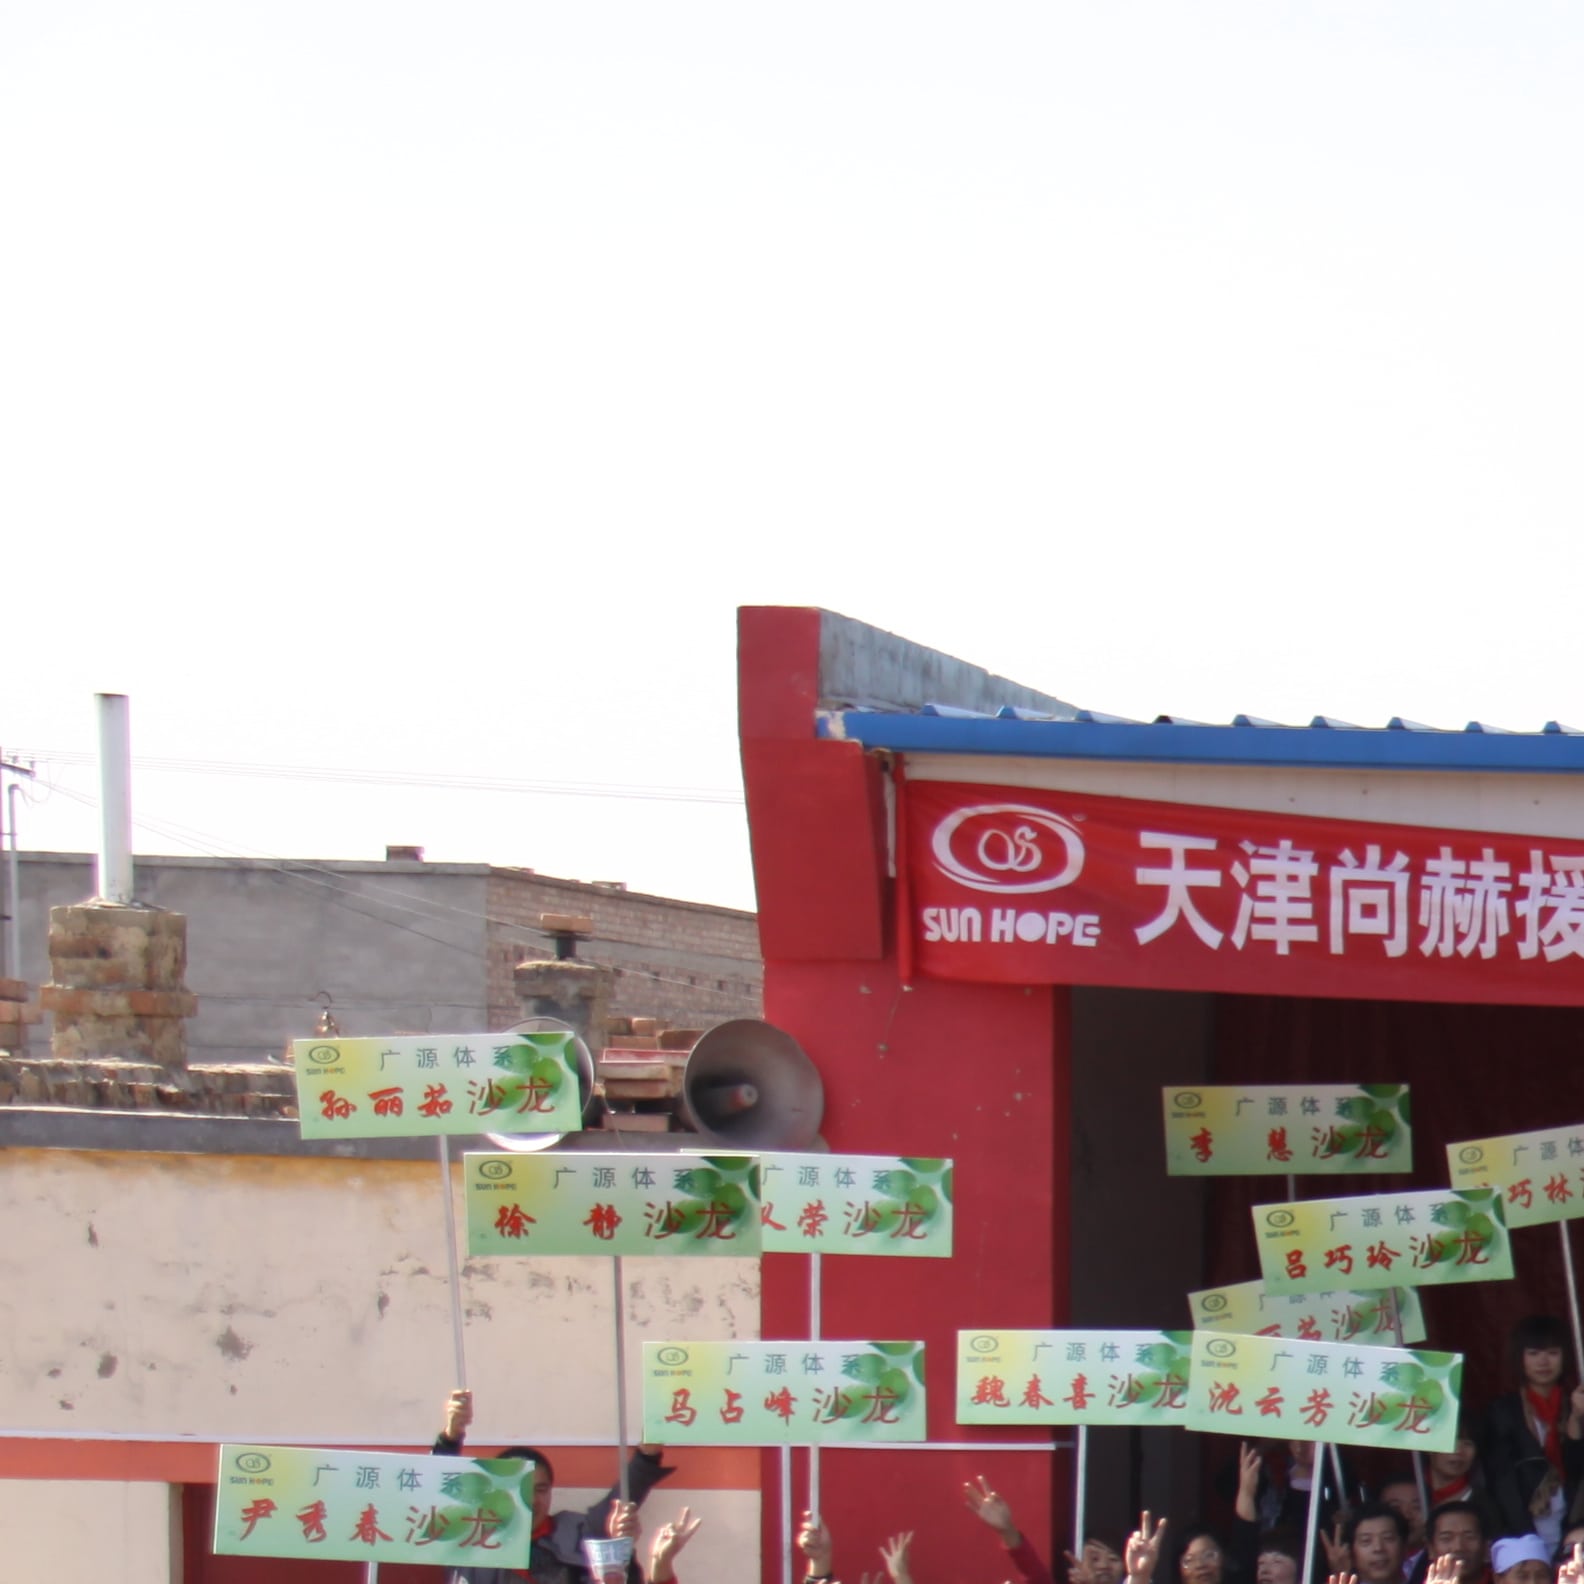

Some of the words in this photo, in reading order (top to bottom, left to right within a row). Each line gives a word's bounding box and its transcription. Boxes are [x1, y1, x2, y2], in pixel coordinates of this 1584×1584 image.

[923, 907, 982, 943] SUN
[990, 908, 1101, 947] HOPE
[379, 1045, 515, 1071] 广源体系
[320, 1077, 555, 1120] 孙丽茹沙龙
[553, 1166, 697, 1190] 广源体系
[726, 1353, 863, 1376] 广源体系
[1033, 1342, 1156, 1363] 广源体系
[1270, 1351, 1400, 1383] 广源体系
[664, 1385, 901, 1427] 马占峰沙龙
[313, 1464, 465, 1493] 广源体系
[239, 1497, 503, 1550] 尹秀春沙龙
